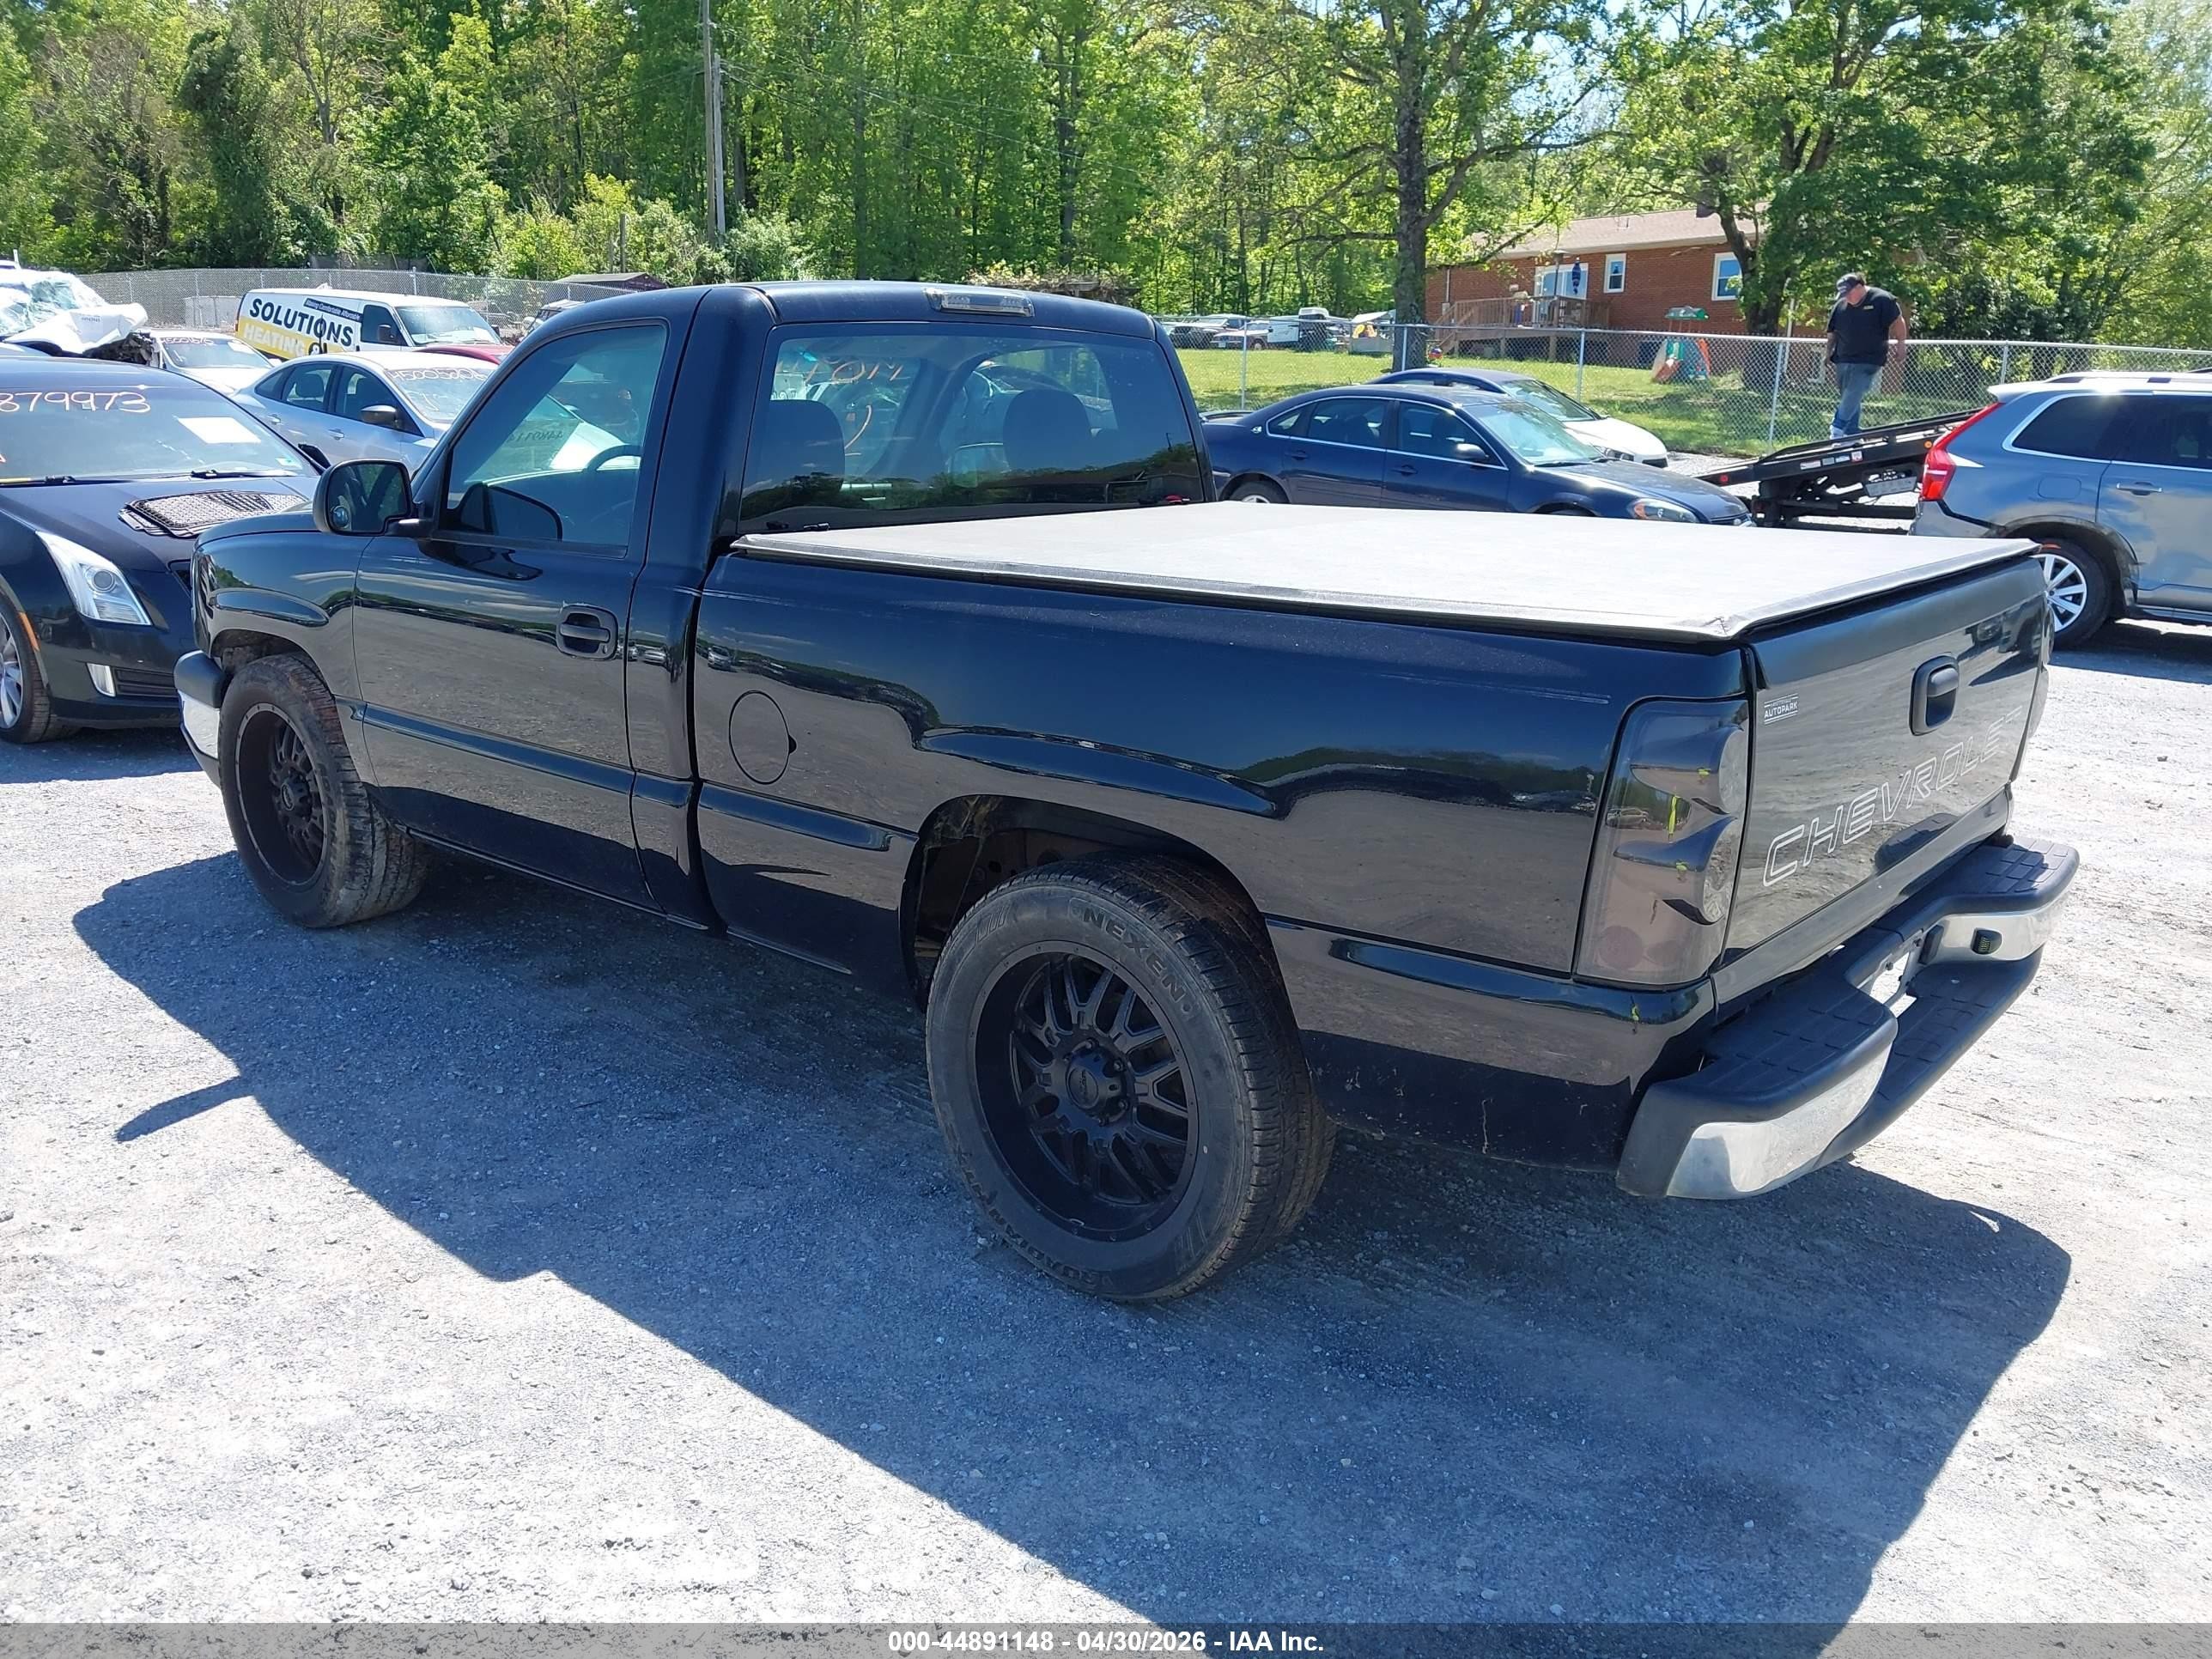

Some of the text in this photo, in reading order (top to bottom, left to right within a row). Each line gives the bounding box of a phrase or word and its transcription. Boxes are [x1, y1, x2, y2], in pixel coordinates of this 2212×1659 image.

[243, 322, 305, 358] HEATING
[249, 298, 354, 347] SOLUTIONS
[0, 392, 151, 413] 879973
[1764, 701, 1798, 719] AUTOPARK
[1083, 908, 1187, 1003] NEXEN
